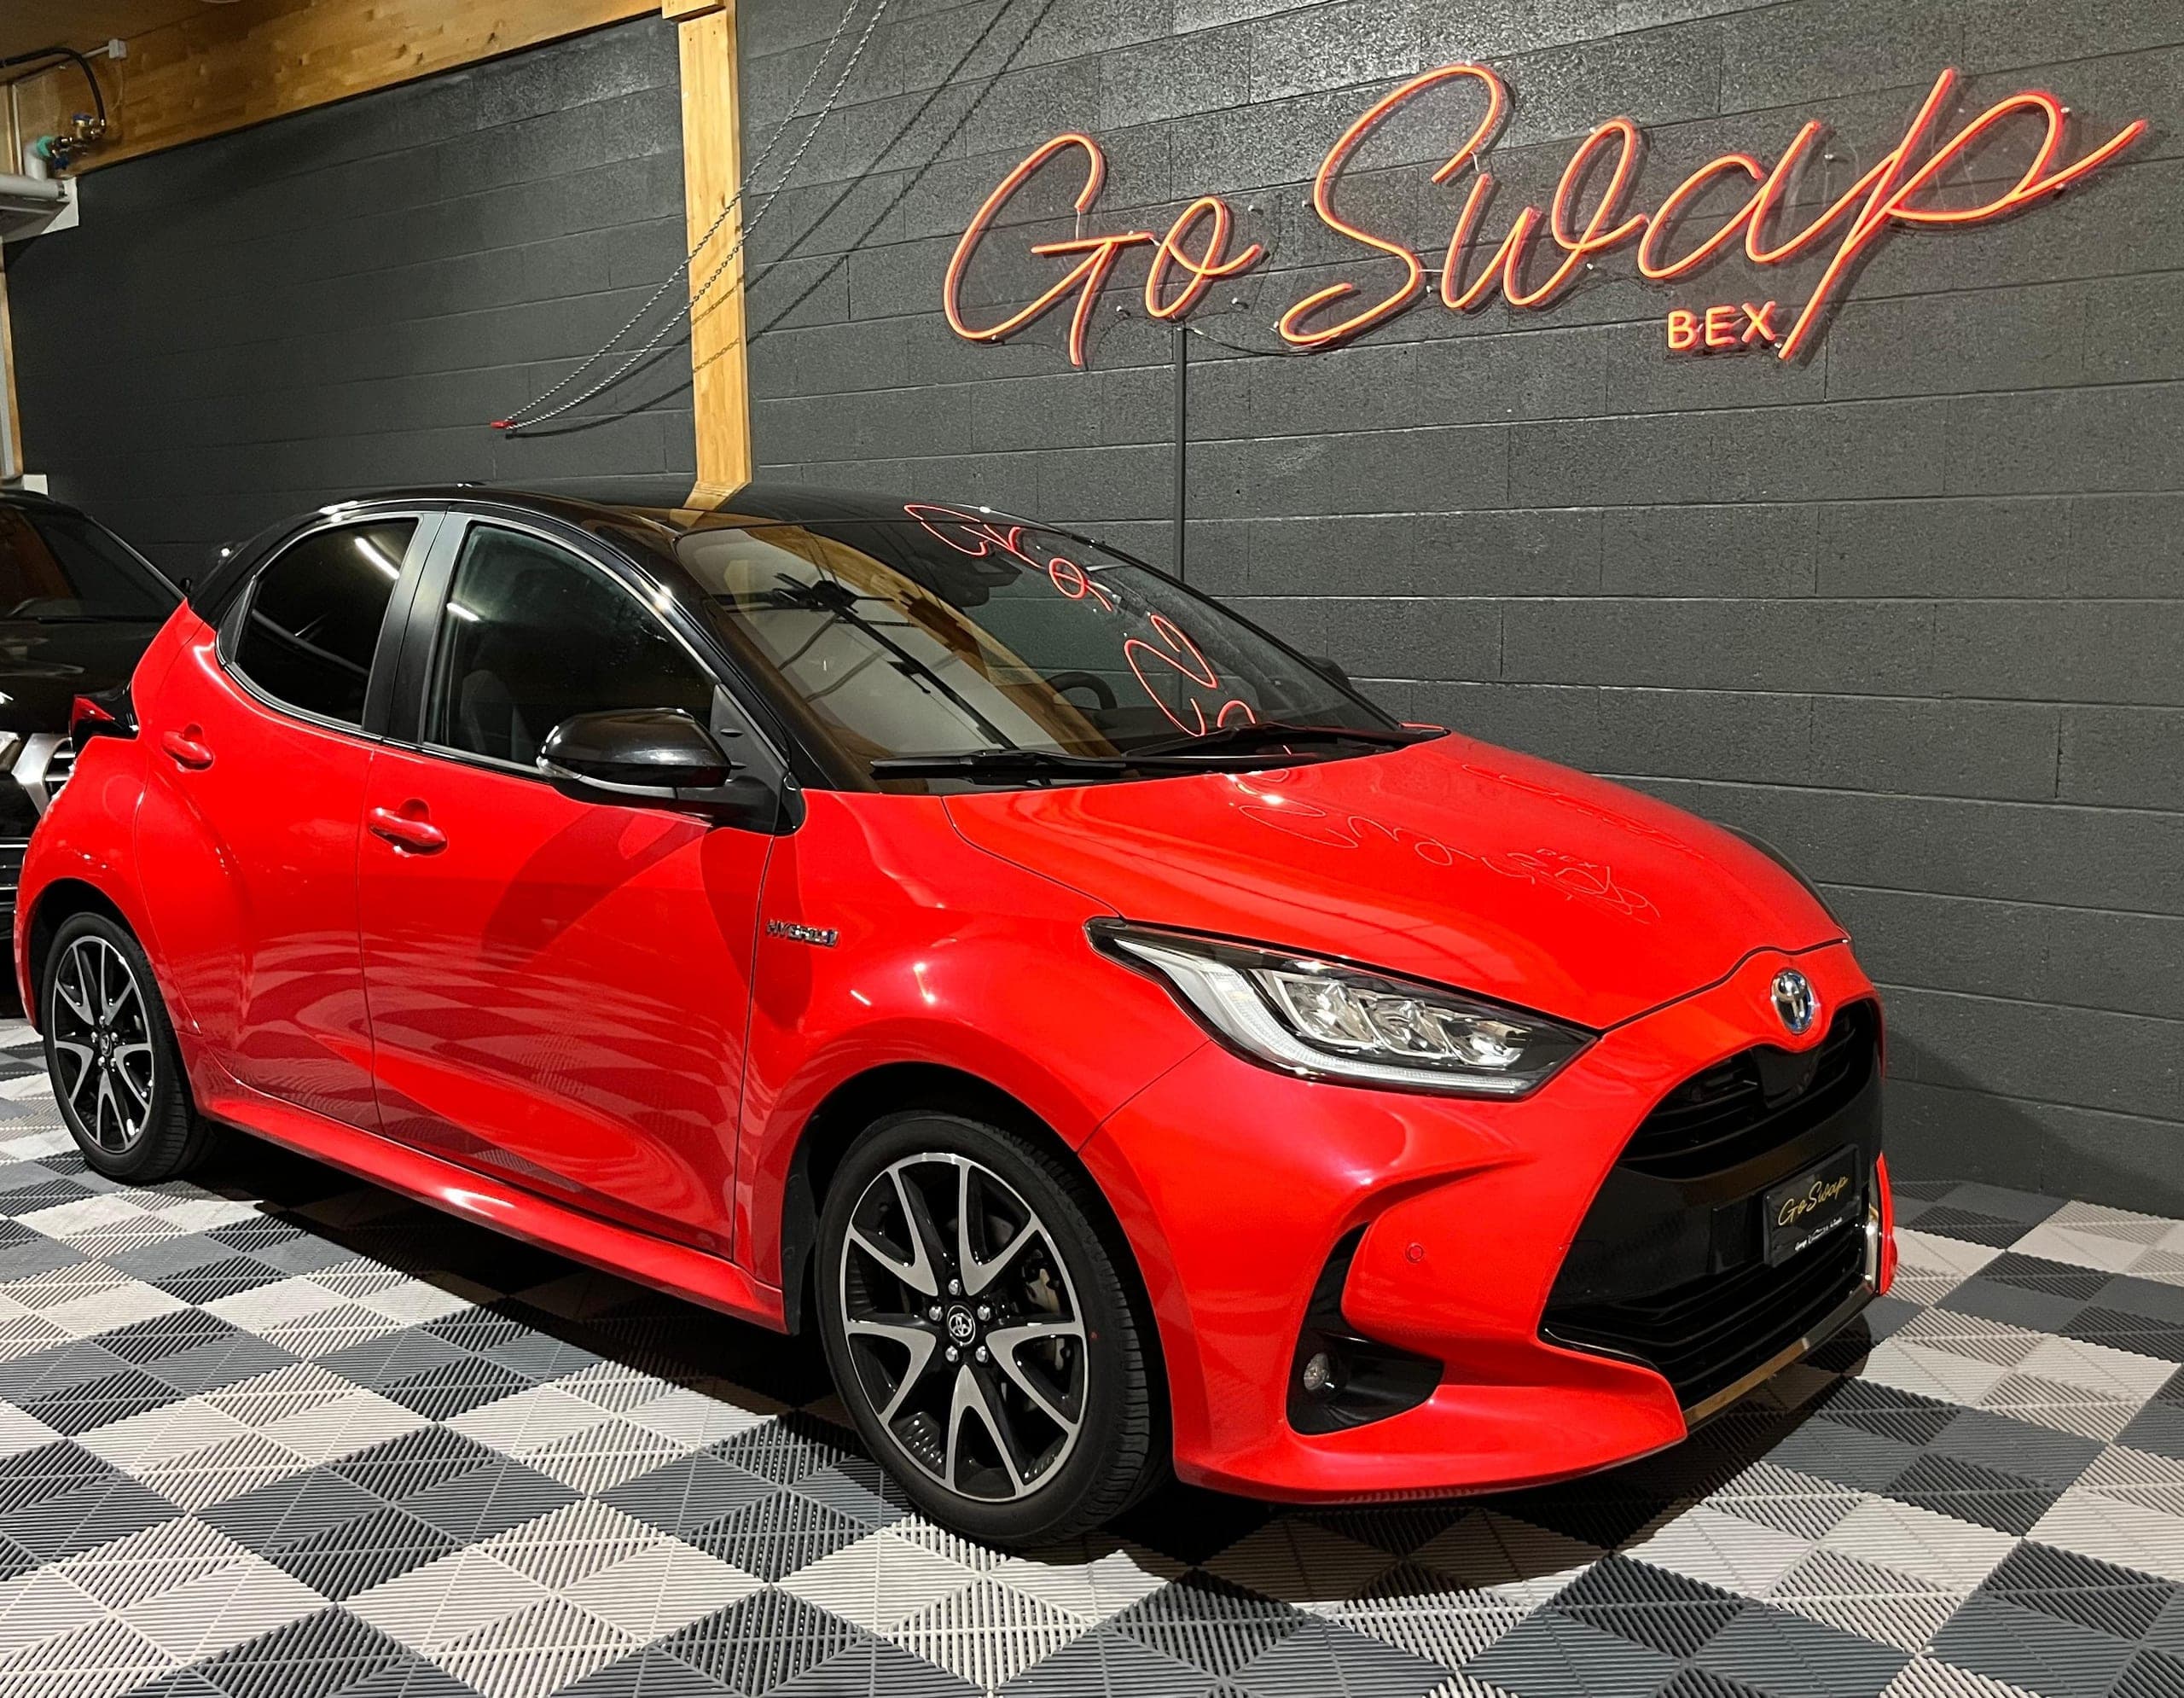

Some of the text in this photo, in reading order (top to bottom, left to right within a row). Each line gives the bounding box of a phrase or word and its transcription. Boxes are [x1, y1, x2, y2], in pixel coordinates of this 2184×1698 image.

[945, 63, 2146, 366] Go Swap
[1667, 300, 1777, 351] BEX
